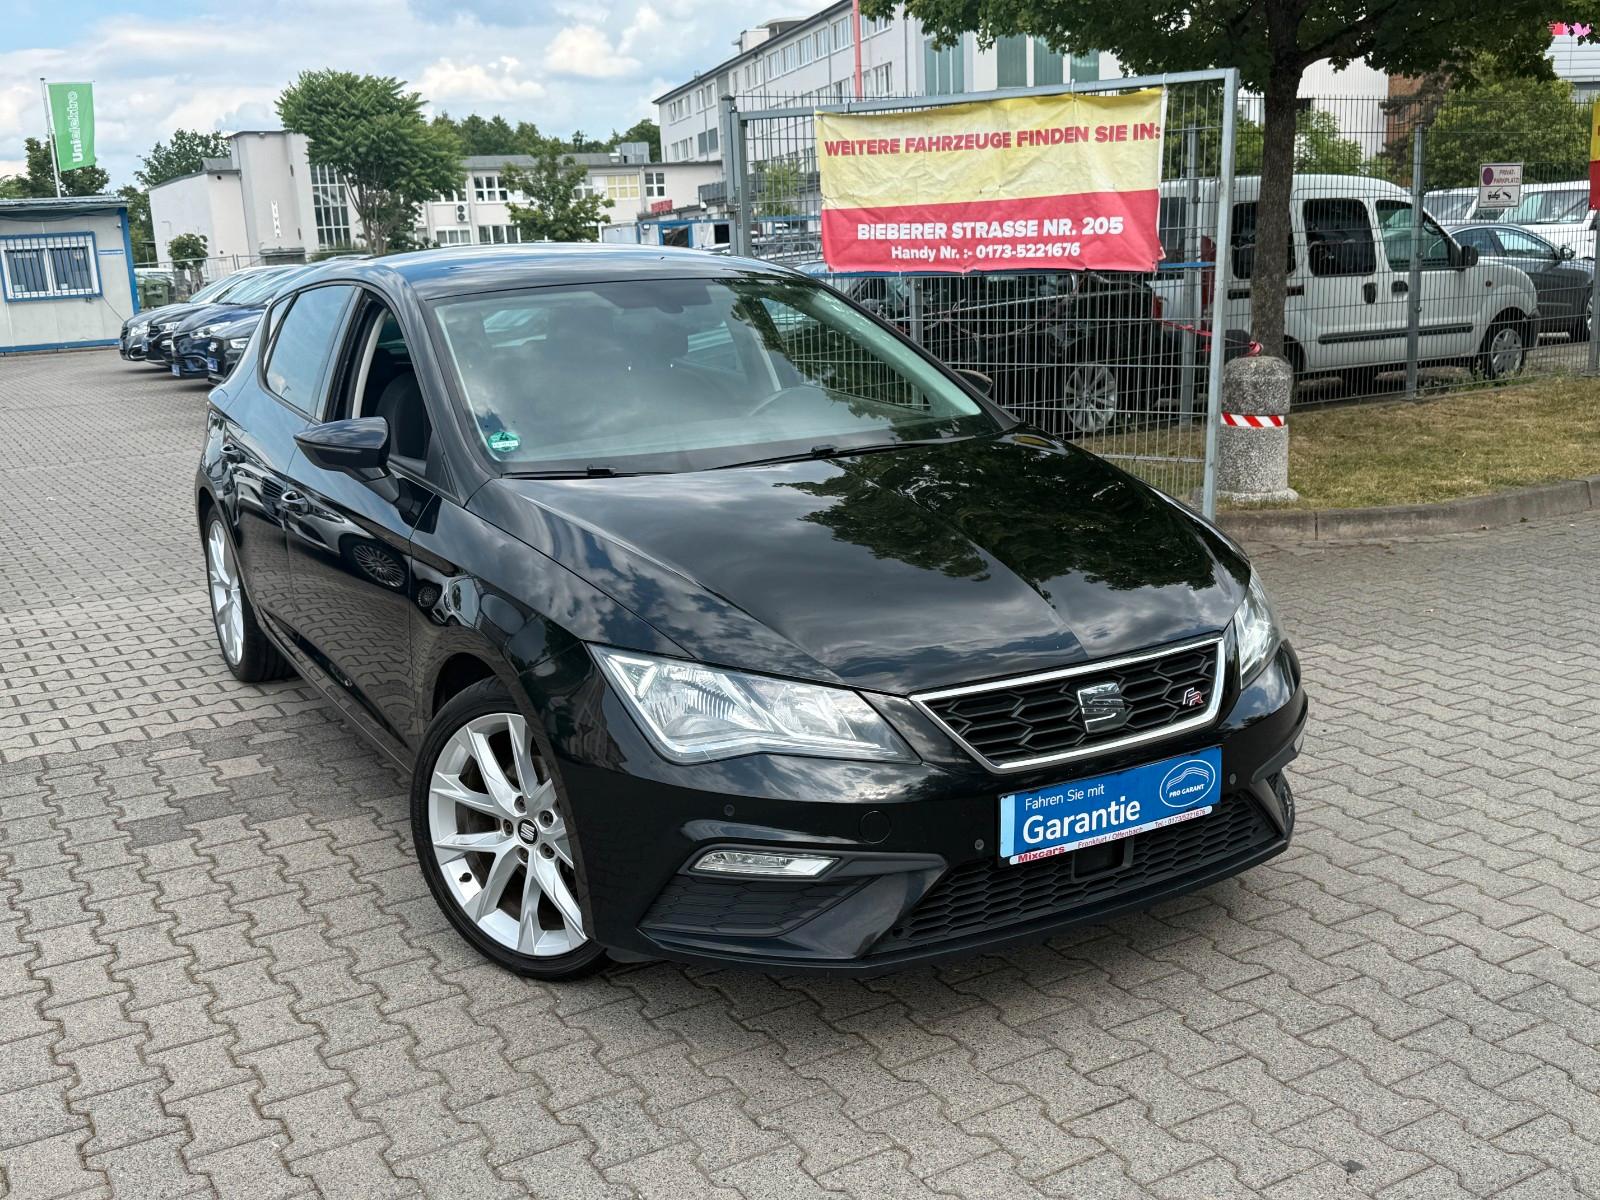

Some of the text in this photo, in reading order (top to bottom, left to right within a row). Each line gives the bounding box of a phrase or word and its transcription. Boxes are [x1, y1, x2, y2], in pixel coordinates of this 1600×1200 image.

[825, 122, 1161, 157] WEITERE FAHRZEUGE FINDEN SIE IN:
[857, 216, 1124, 240] BIEBERER STRASSE NR. 205
[891, 245, 937, 263] Handy
[939, 245, 960, 259] Nr.
[975, 241, 1081, 259] 0173-5221676
[1025, 783, 1106, 812] Fahren Sie mit
[1168, 783, 1206, 799] PRO GARANT
[1022, 795, 1142, 845] Garantie
[1017, 845, 1066, 864] Mixcars
